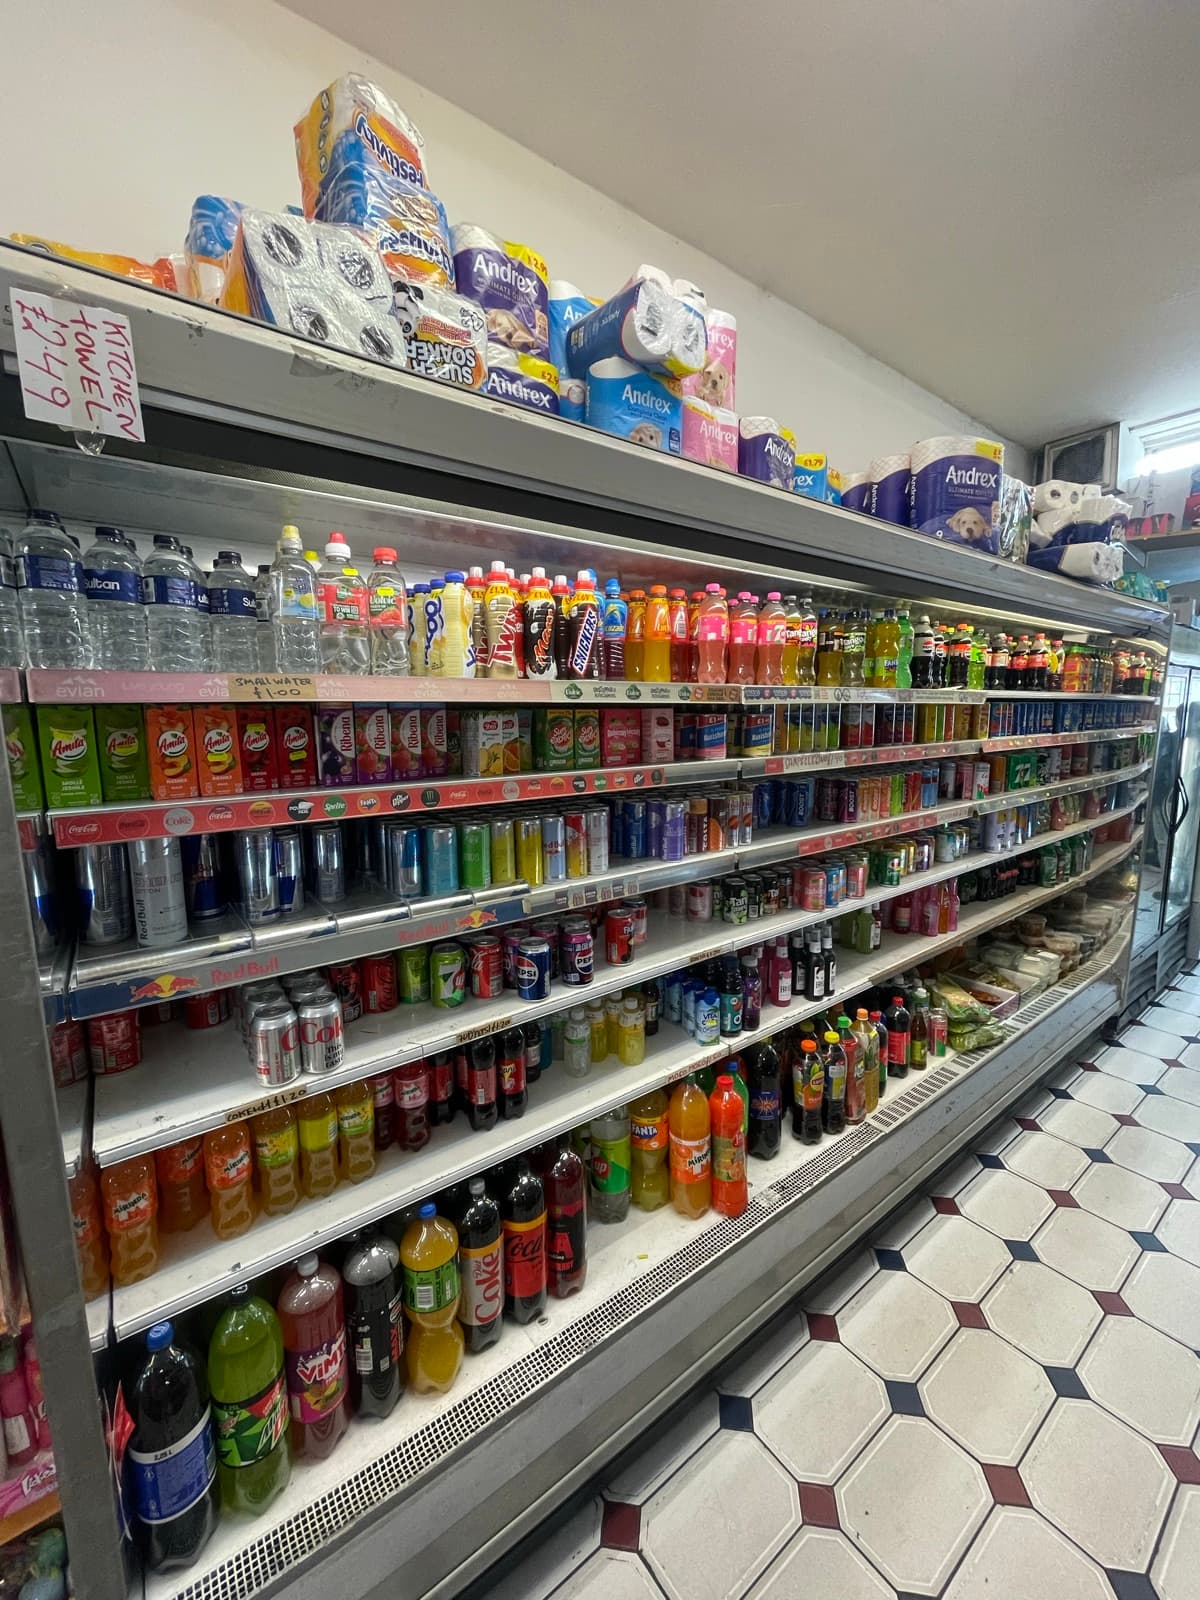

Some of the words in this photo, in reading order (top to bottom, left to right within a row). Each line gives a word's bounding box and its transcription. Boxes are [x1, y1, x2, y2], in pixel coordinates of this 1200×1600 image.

[473, 253, 539, 296] Andrex
[102, 319, 141, 442] KITCHEN
[488, 372, 552, 410] Andrex
[622, 384, 672, 415] Andrex
[700, 419, 738, 447] Andrex
[764, 436, 793, 468] Andrex
[945, 464, 998, 489] Andrex
[572, 610, 598, 674] SNICKERS
[56, 685, 104, 698] evian
[236, 678, 271, 687] SMALL
[273, 678, 313, 687] WATER
[158, 734, 187, 756] Amita
[203, 734, 231, 753] Amita
[339, 716, 351, 752] Ribena
[375, 714, 386, 750] Ribena
[408, 715, 419, 749] Ribena
[435, 714, 446, 747] Ribena
[52, 737, 85, 758] Amita
[323, 802, 346, 812] Sprite
[136, 899, 145, 918] Bull
[140, 918, 149, 940] Red
[211, 964, 247, 984] Red
[250, 957, 279, 975] Bull
[474, 1249, 502, 1325] Coke
